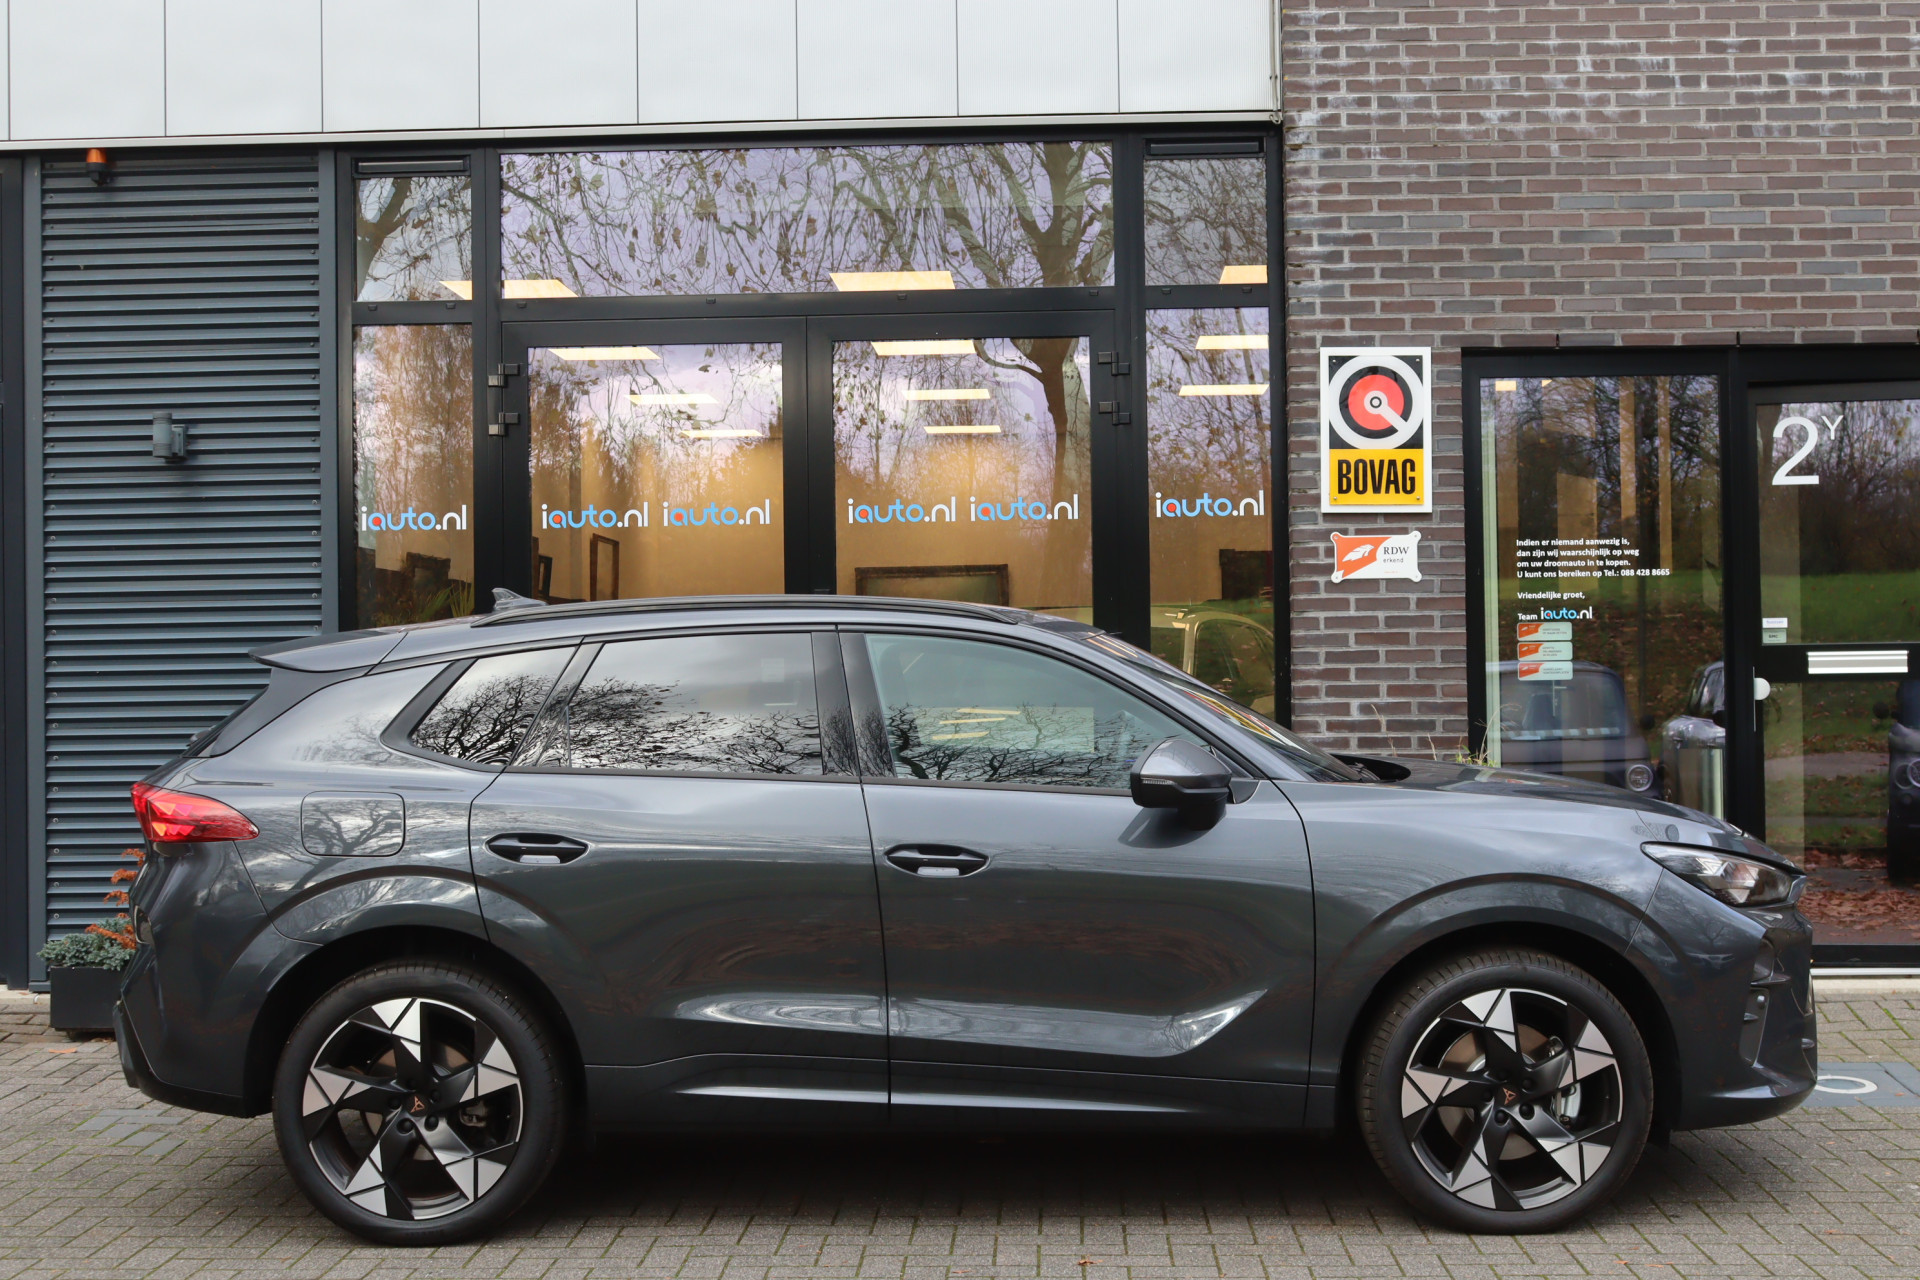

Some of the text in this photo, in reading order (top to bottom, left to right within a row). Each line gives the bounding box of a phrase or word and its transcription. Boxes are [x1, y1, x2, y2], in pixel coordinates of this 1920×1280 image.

[1772, 415, 1844, 486] 2 Y
[1337, 458, 1416, 495] BOVAG
[847, 493, 1079, 524] iauto.nl iauto.nl
[1155, 490, 1265, 518] iauto.nl
[361, 504, 468, 531] iauto.nl
[541, 498, 771, 530] iauto.nl iauto.nl
[1516, 538, 1540, 546] Indien
[1551, 538, 1584, 546] niemand
[1585, 537, 1620, 546] aanwezig
[1621, 537, 1630, 546] is,
[1383, 546, 1409, 555] RDW
[1516, 549, 1531, 557] dan
[1532, 549, 1545, 558] zijn
[1546, 549, 1558, 558] wij
[1560, 548, 1611, 558] waarschijnlijk
[1612, 549, 1622, 557] op
[1544, 559, 1586, 568] droomauto
[1587, 559, 1595, 567] in
[1596, 559, 1604, 567] te
[1605, 559, 1631, 568] kopen.
[1516, 570, 1523, 578] U
[1524, 570, 1542, 578] kunt
[1558, 570, 1591, 578] bereiken
[1592, 570, 1602, 579] op
[1603, 569, 1619, 577] Tel.:
[1620, 569, 1635, 577] 088
[1636, 569, 1650, 577] 428
[1651, 568, 1670, 576] 8665
[1517, 591, 1586, 601] Vriendelijke groet,
[1517, 606, 1593, 621] Team iauto.nl
